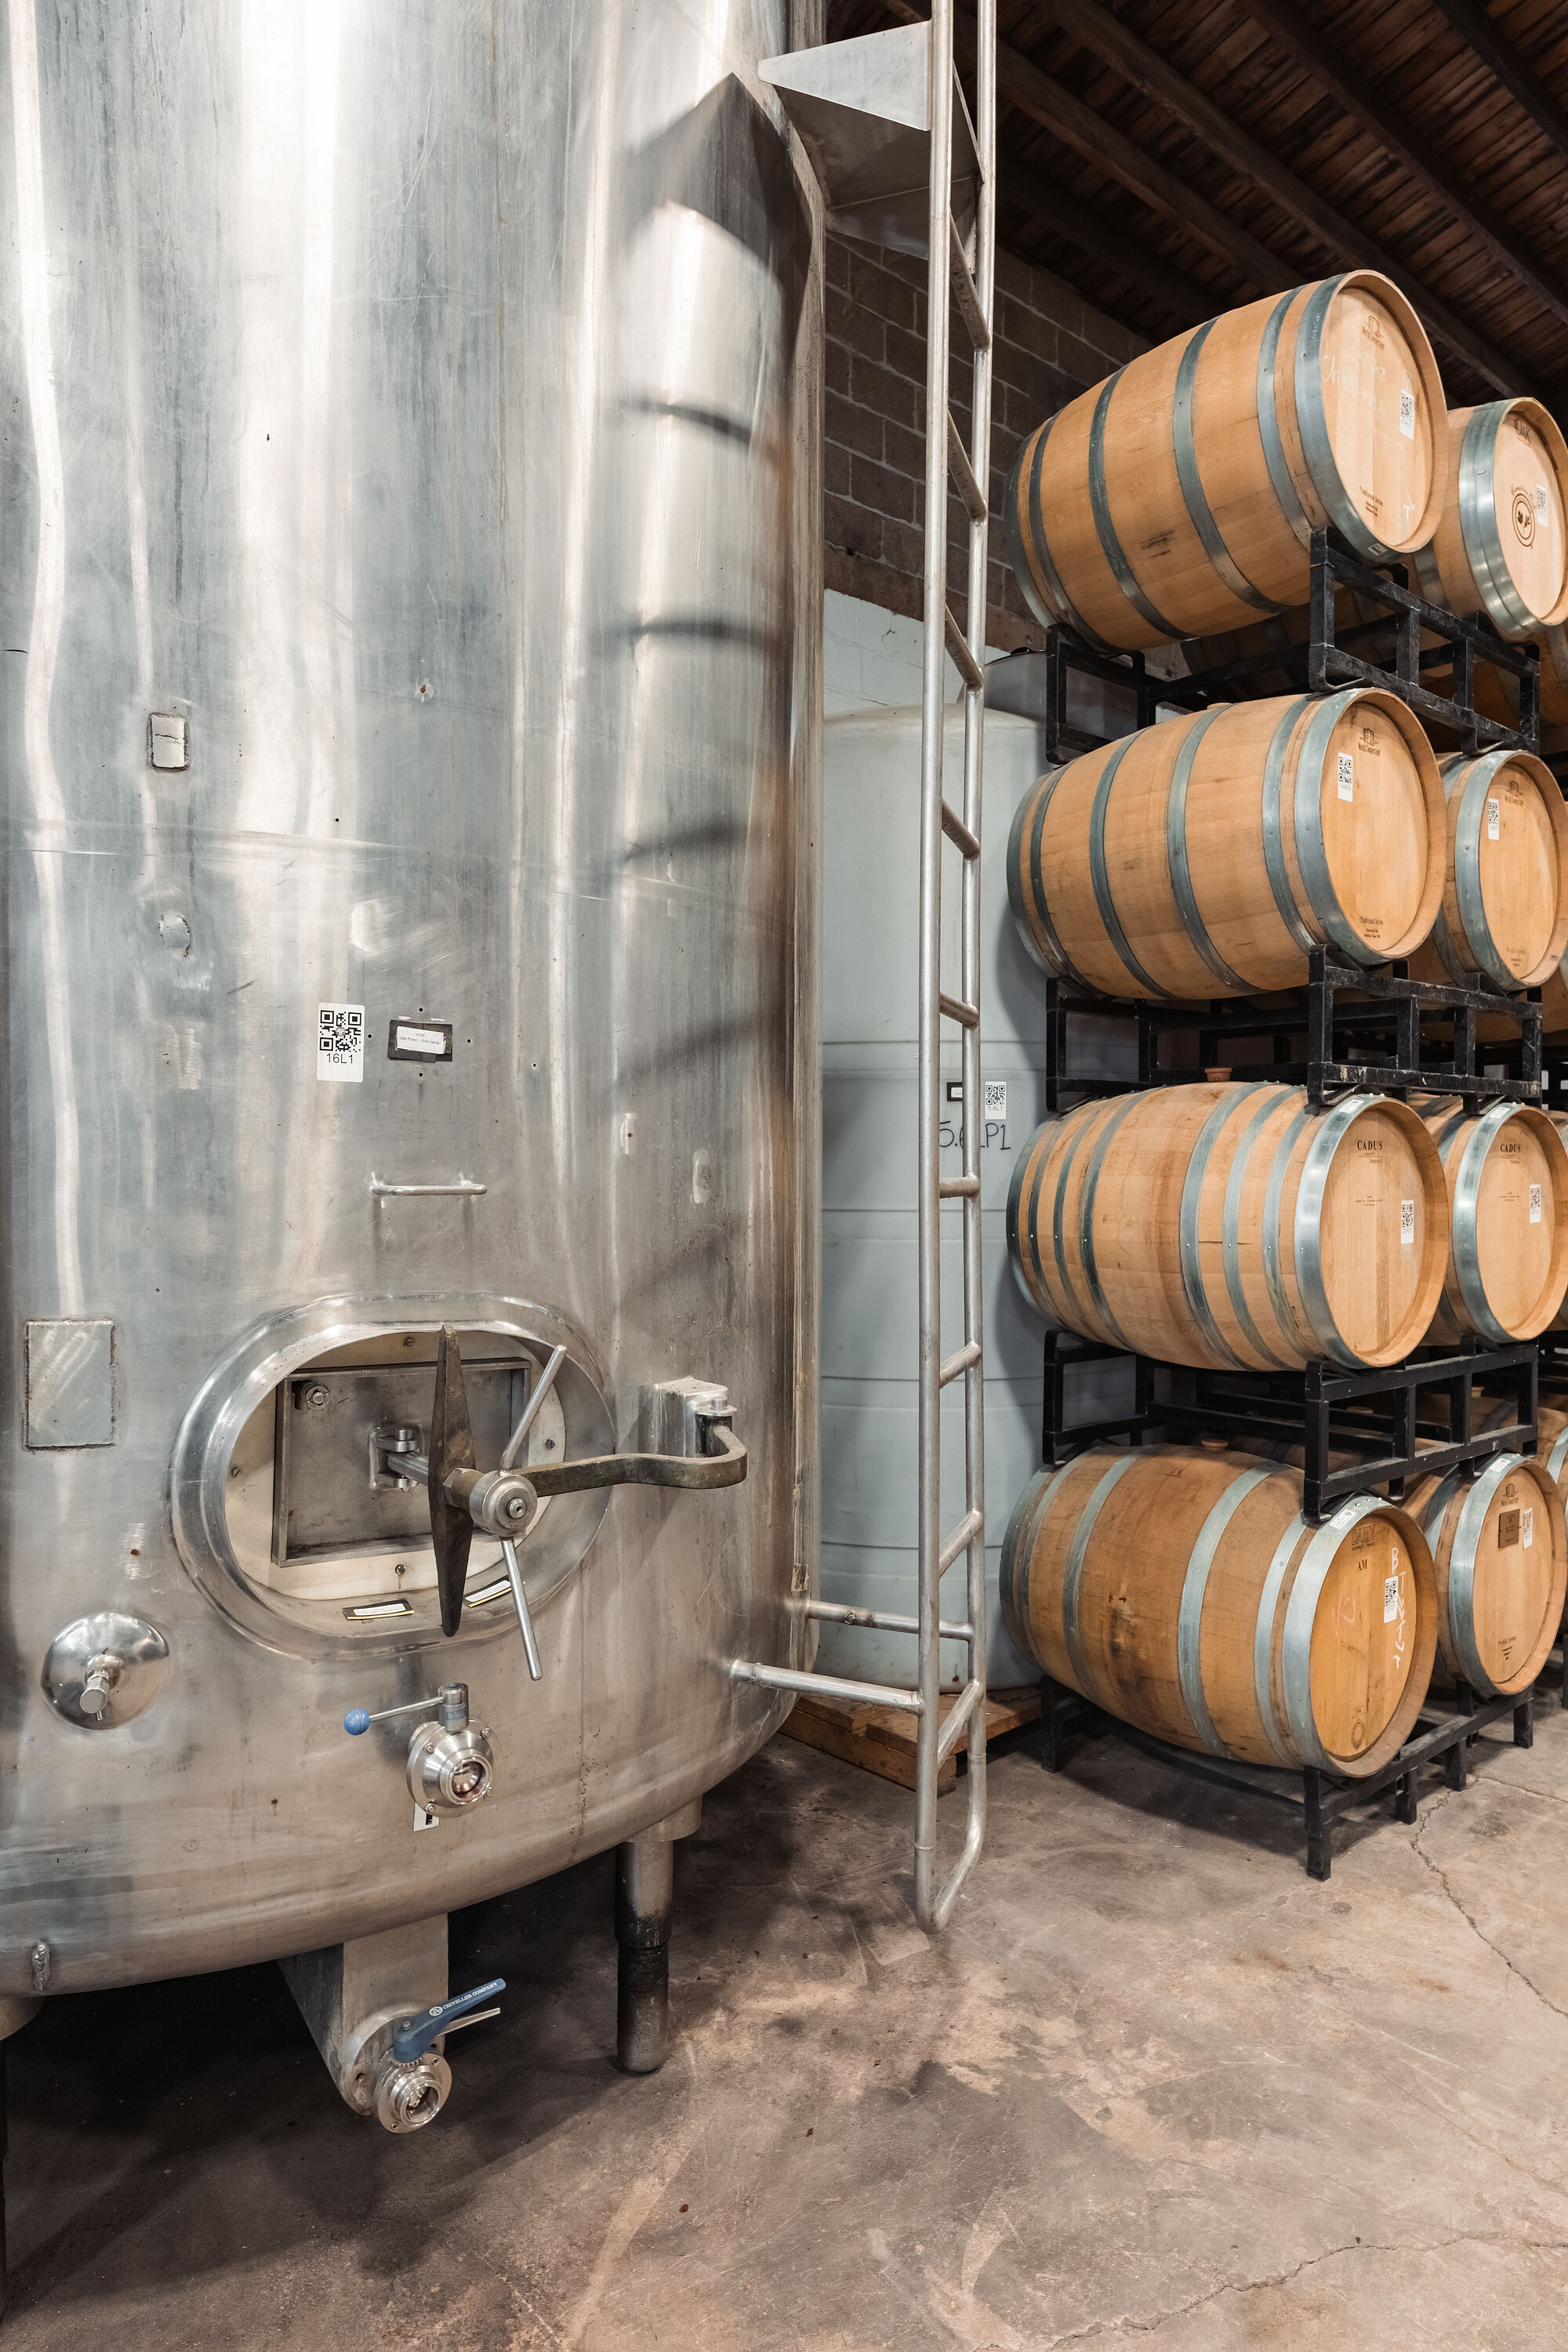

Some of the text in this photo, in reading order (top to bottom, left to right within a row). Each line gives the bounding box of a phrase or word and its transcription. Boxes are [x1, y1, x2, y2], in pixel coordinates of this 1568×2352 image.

[326, 1053, 353, 1065] 16L1
[1357, 1140, 1383, 1151] CADUS
[1500, 1143, 1521, 1152] CADUS
[1352, 1524, 1376, 1546] DAMY
[1356, 1559, 1367, 1571] AM
[442, 1982, 498, 2009] CRIVELLER COMPANY
